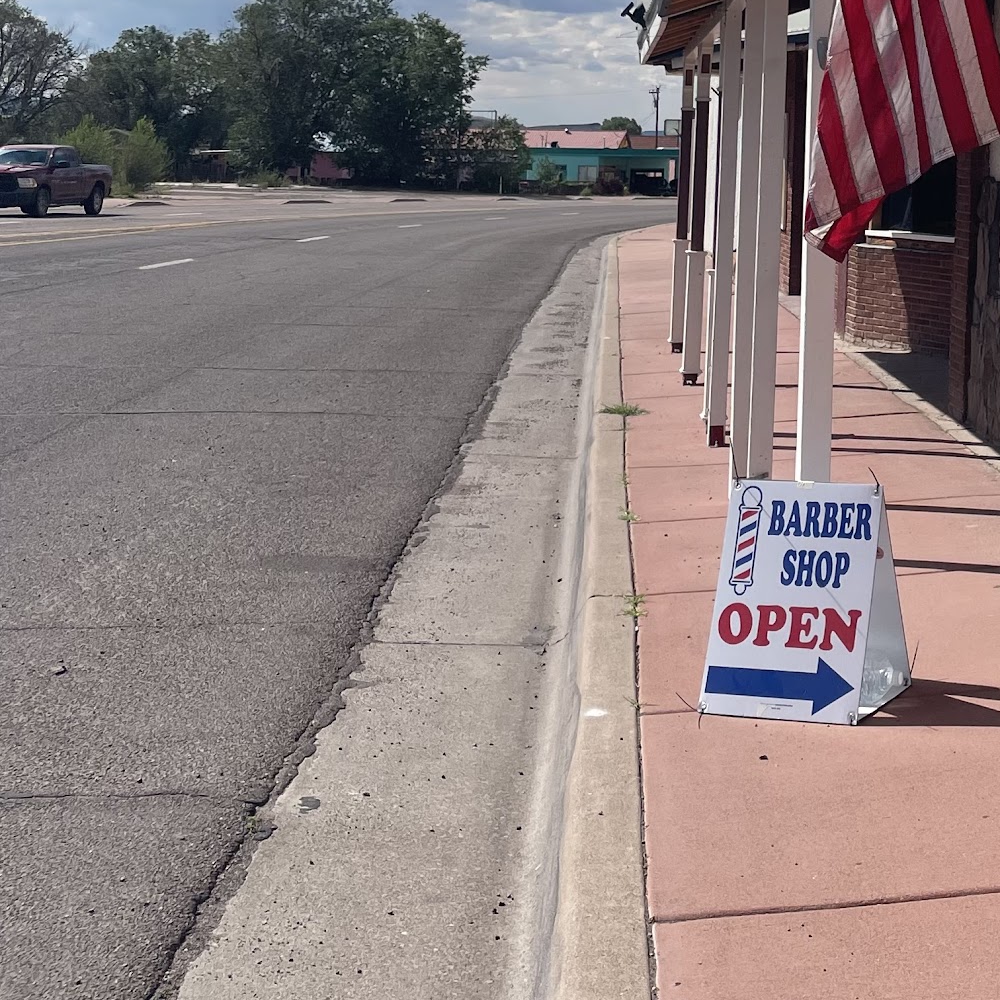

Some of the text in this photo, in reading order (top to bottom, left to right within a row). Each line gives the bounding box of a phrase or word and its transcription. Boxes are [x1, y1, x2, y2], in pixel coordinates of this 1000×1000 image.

[768, 500, 872, 540] BARBER
[780, 549, 850, 588] SHOP
[718, 602, 862, 653] OPEN
